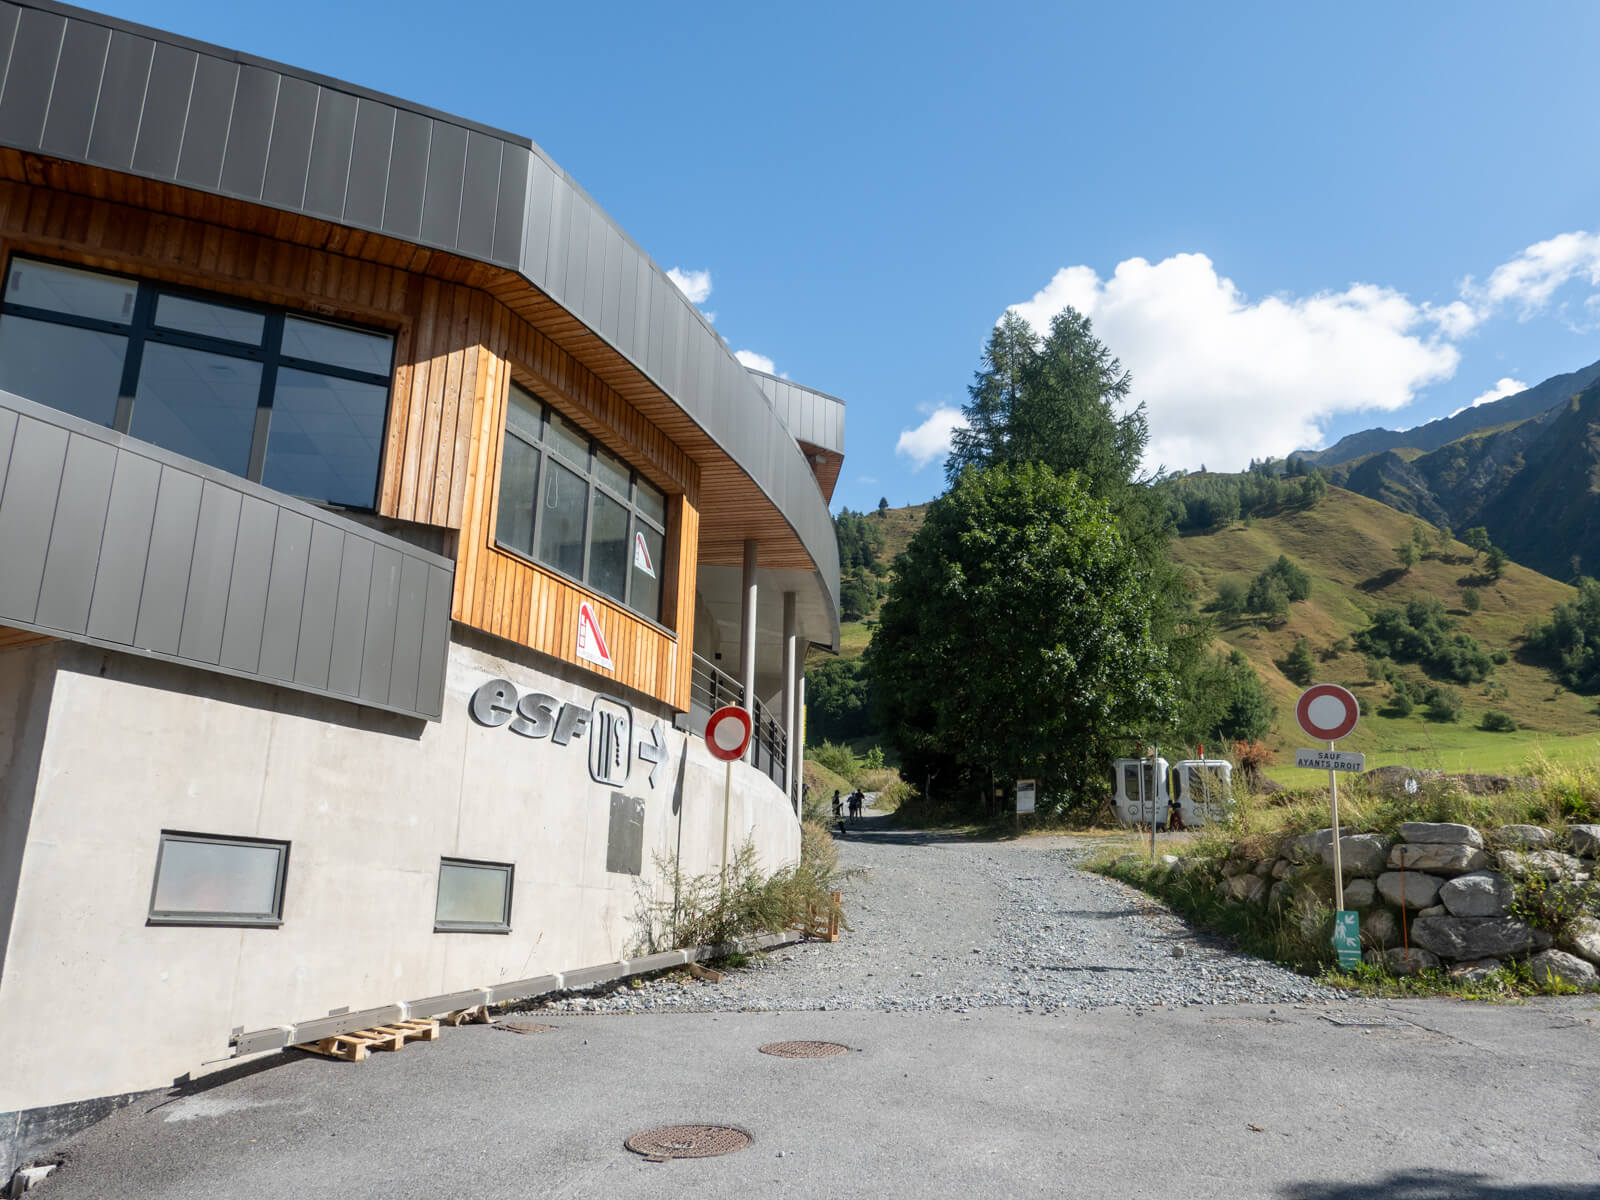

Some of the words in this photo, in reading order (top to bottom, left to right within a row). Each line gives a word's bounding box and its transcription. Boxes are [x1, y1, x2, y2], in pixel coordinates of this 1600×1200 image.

[1318, 752, 1342, 760] SAUF
[1298, 758, 1331, 768] AYANTS
[1334, 761, 1361, 771] DROIT
